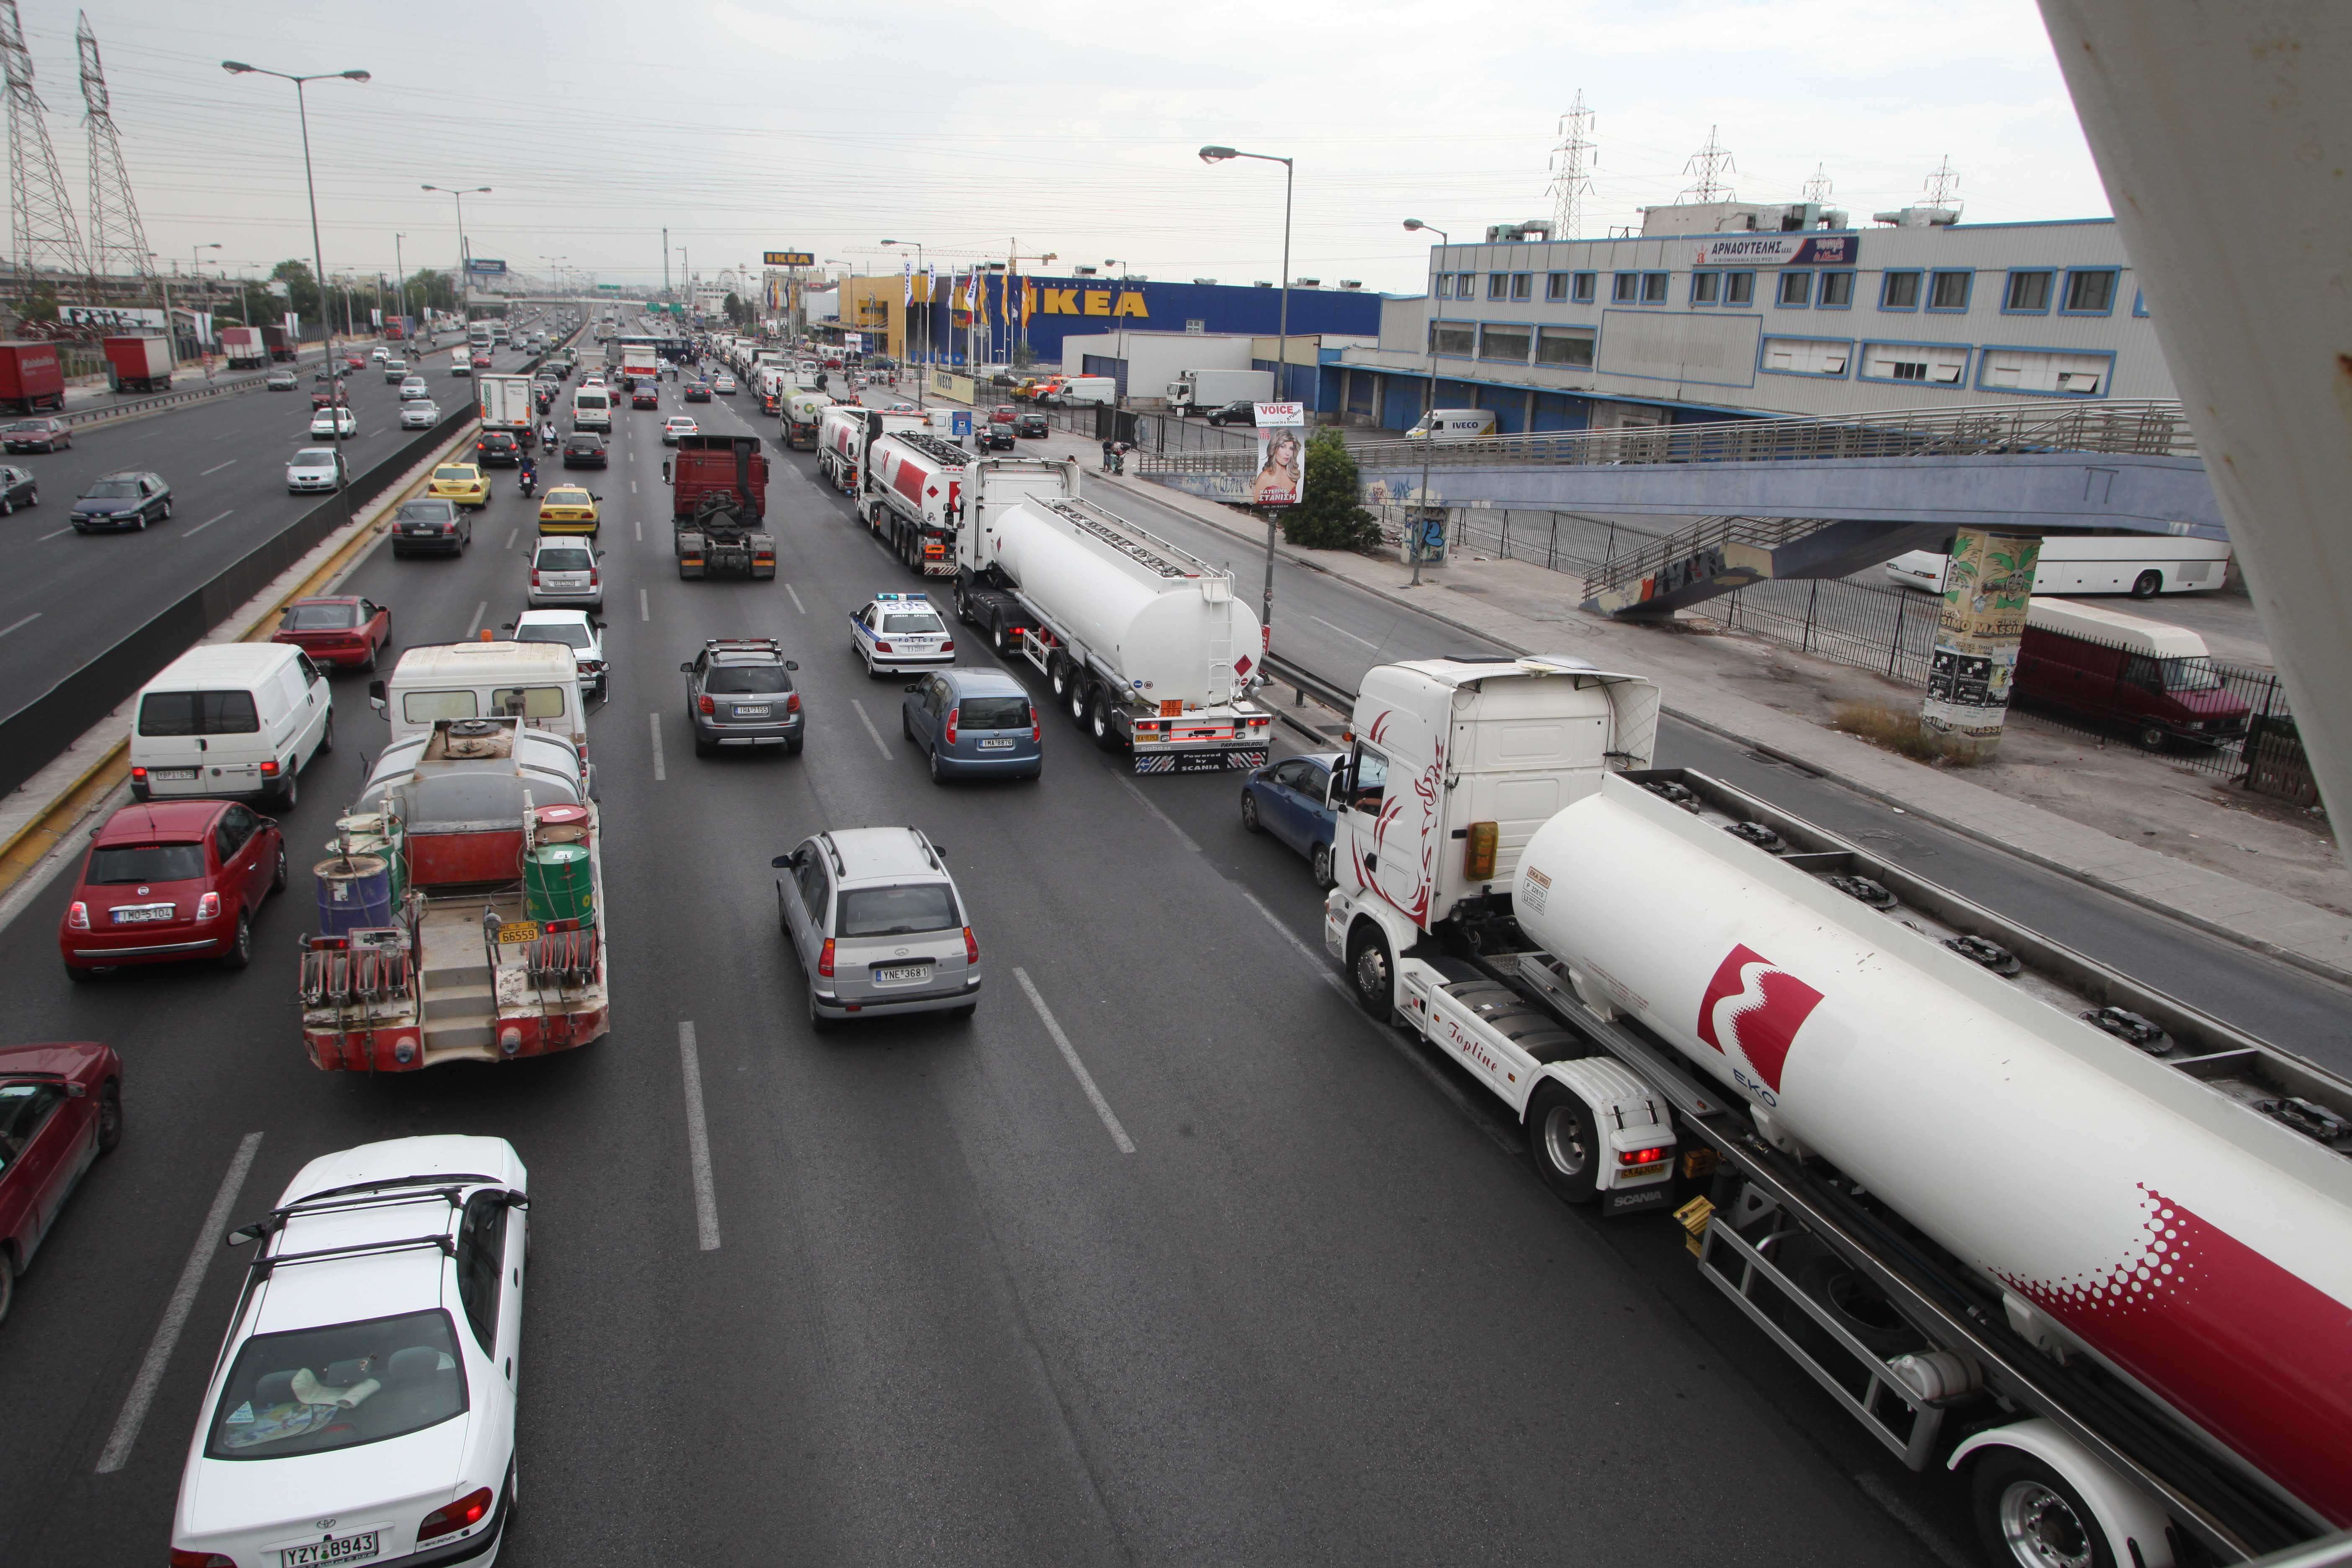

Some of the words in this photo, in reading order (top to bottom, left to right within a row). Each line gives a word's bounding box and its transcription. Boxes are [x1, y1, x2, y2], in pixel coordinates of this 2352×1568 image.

[1712, 241, 1782, 255] ΑΡΝΑΟΥΤΕΛΗΣ
[767, 253, 810, 263] IKEA
[937, 374, 952, 390] IVECO
[1260, 405, 1294, 415] VOICE
[1286, 409, 1301, 421] STUDIO
[886, 602, 928, 610] 505
[1529, 869, 1538, 879] EKA
[1531, 886, 1544, 898] 22610
[503, 930, 534, 942] 66559
[1447, 1021, 1497, 1073] Topline
[1733, 1068, 1777, 1107] EKO
[1614, 1190, 1662, 1207] SCANIA
[288, 1545, 319, 1565] YZY
[331, 1534, 372, 1557] 8943
